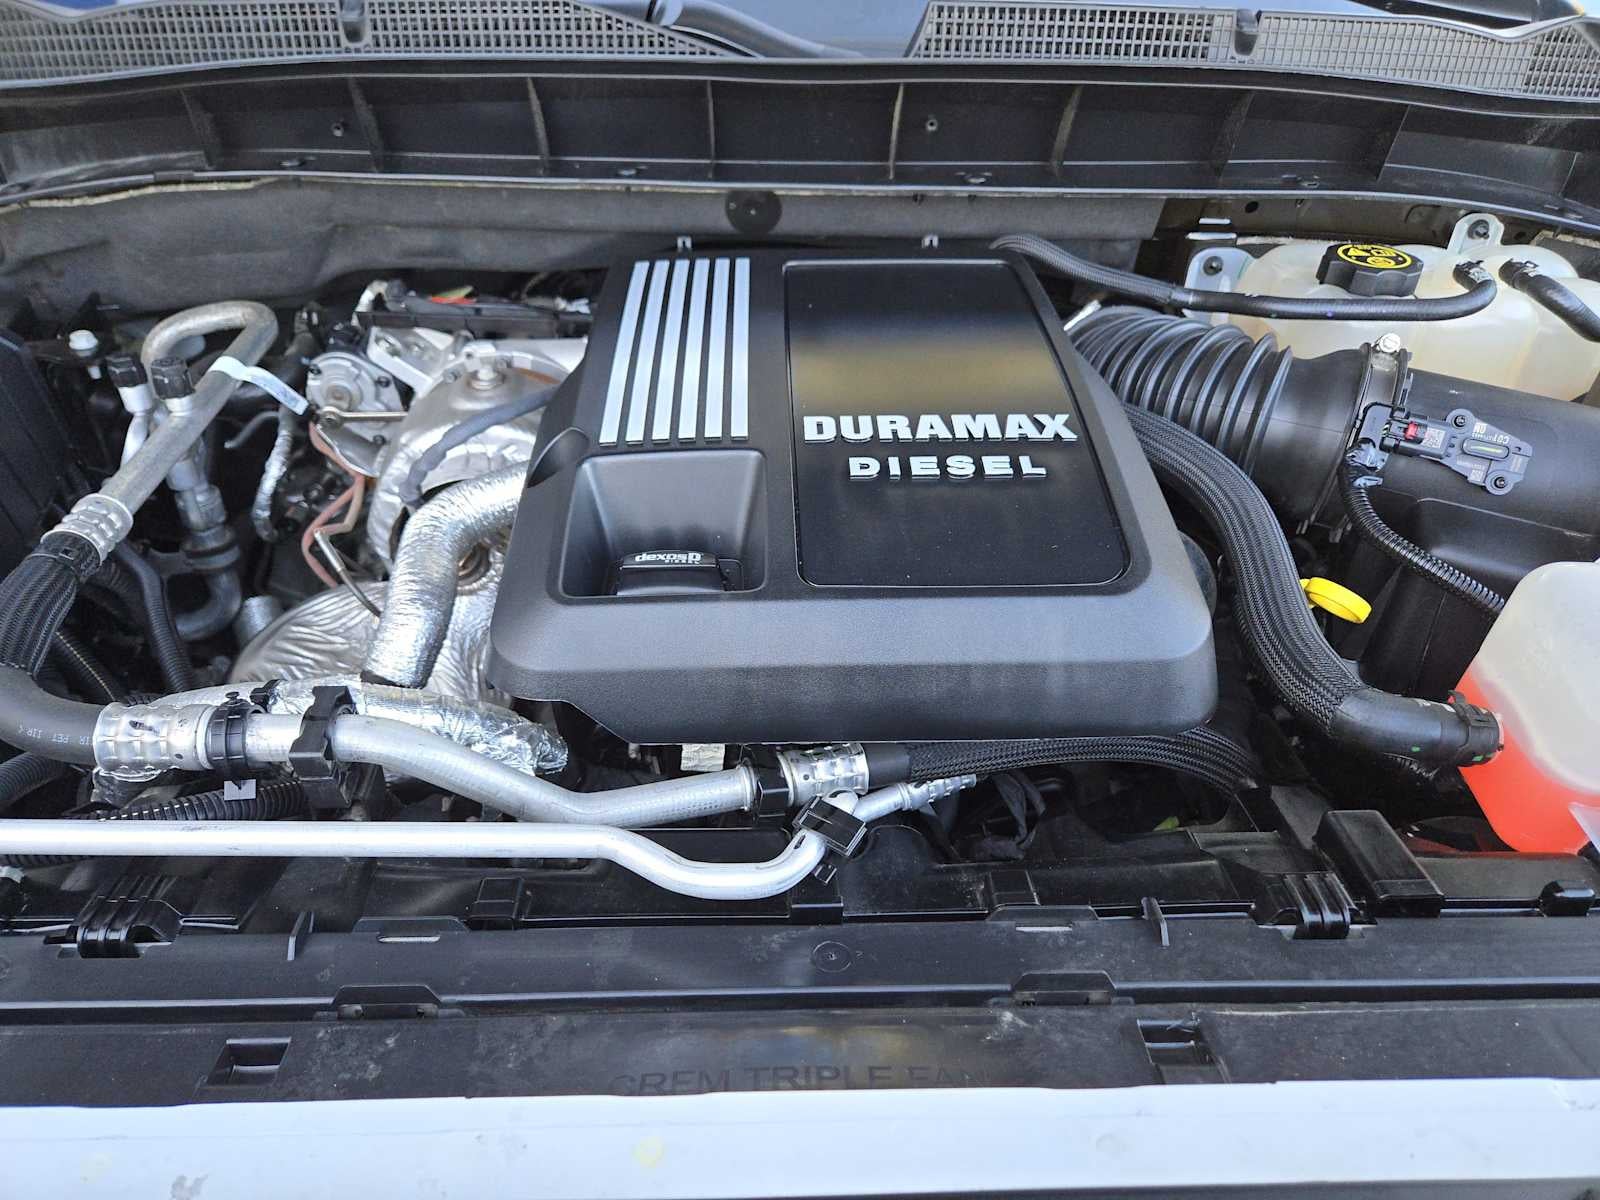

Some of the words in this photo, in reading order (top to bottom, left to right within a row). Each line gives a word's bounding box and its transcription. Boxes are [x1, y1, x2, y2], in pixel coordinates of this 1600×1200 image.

[803, 413, 1078, 442] DURAMAX
[848, 456, 1047, 479] DIESEL
[745, 1065, 893, 1091] TRIPLE
